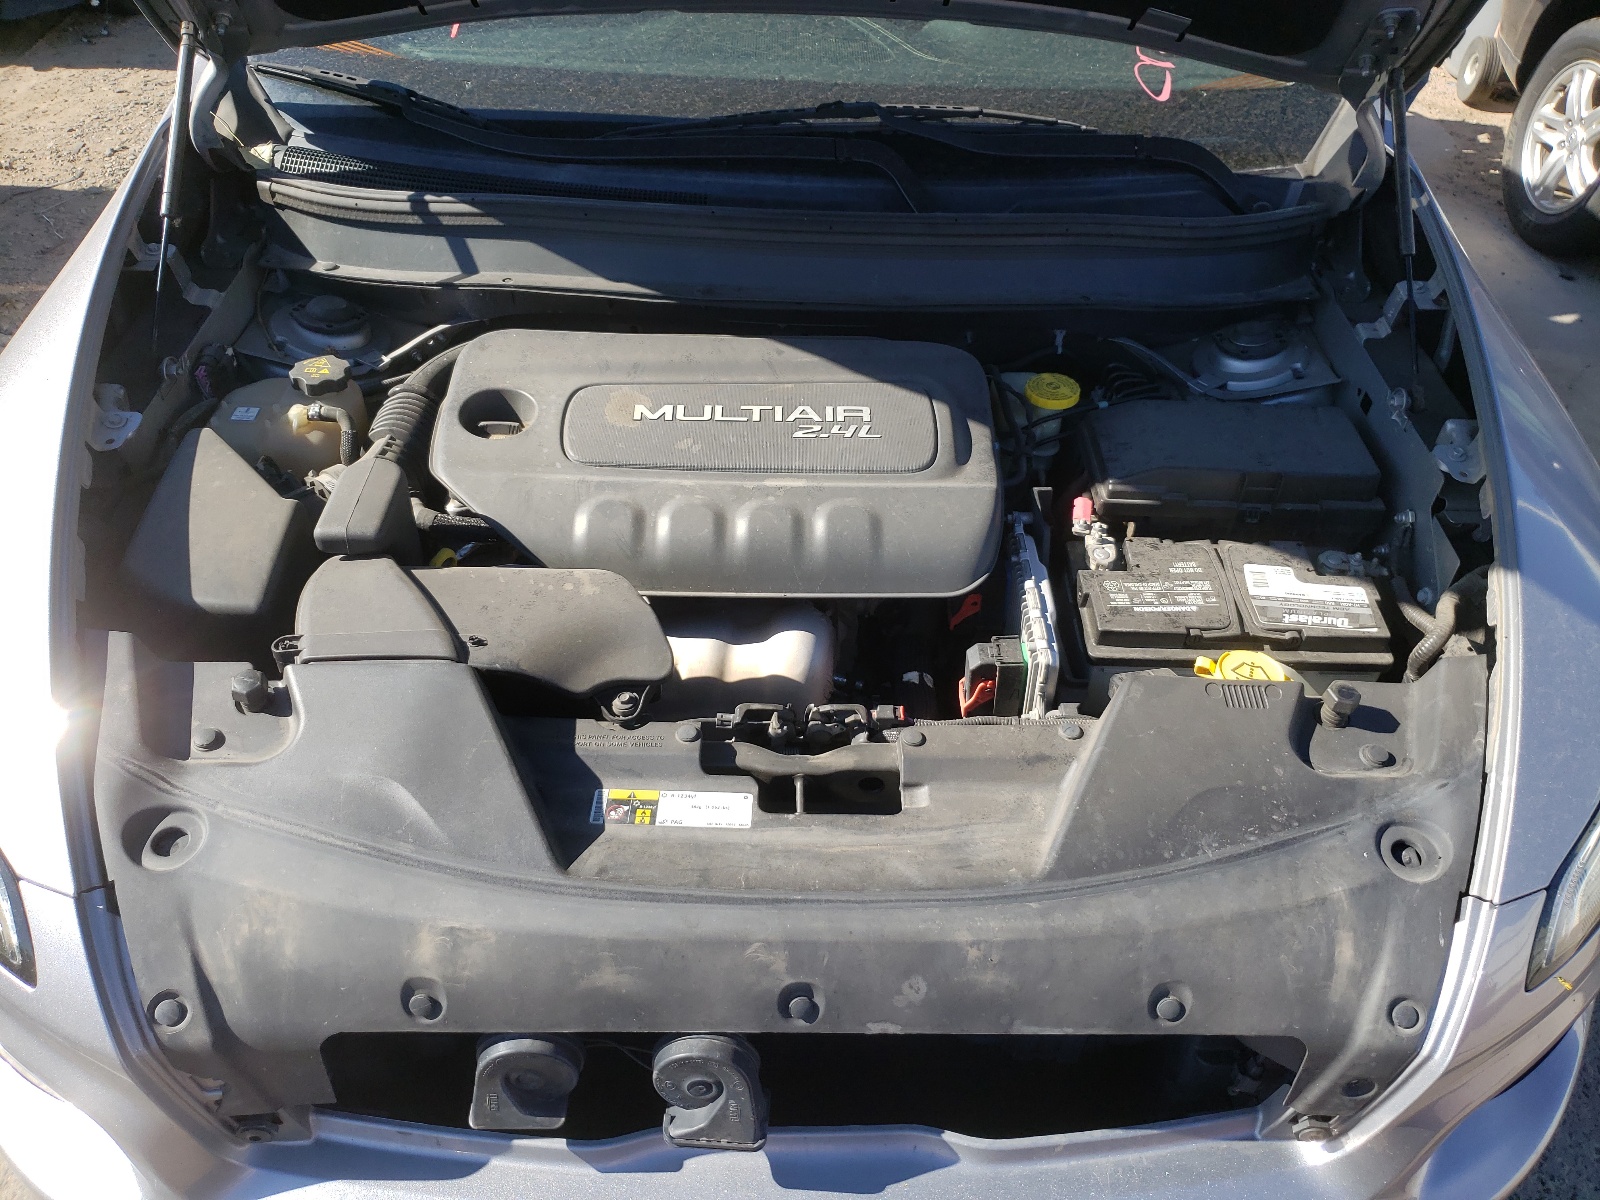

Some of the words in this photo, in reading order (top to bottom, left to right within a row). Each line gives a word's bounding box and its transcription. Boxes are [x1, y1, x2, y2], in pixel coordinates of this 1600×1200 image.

[632, 404, 872, 423] MULTIAIR
[792, 424, 882, 439] 2.4L
[1278, 602, 1329, 611] TECHNOLOGY
[1281, 613, 1349, 627] Duralast
